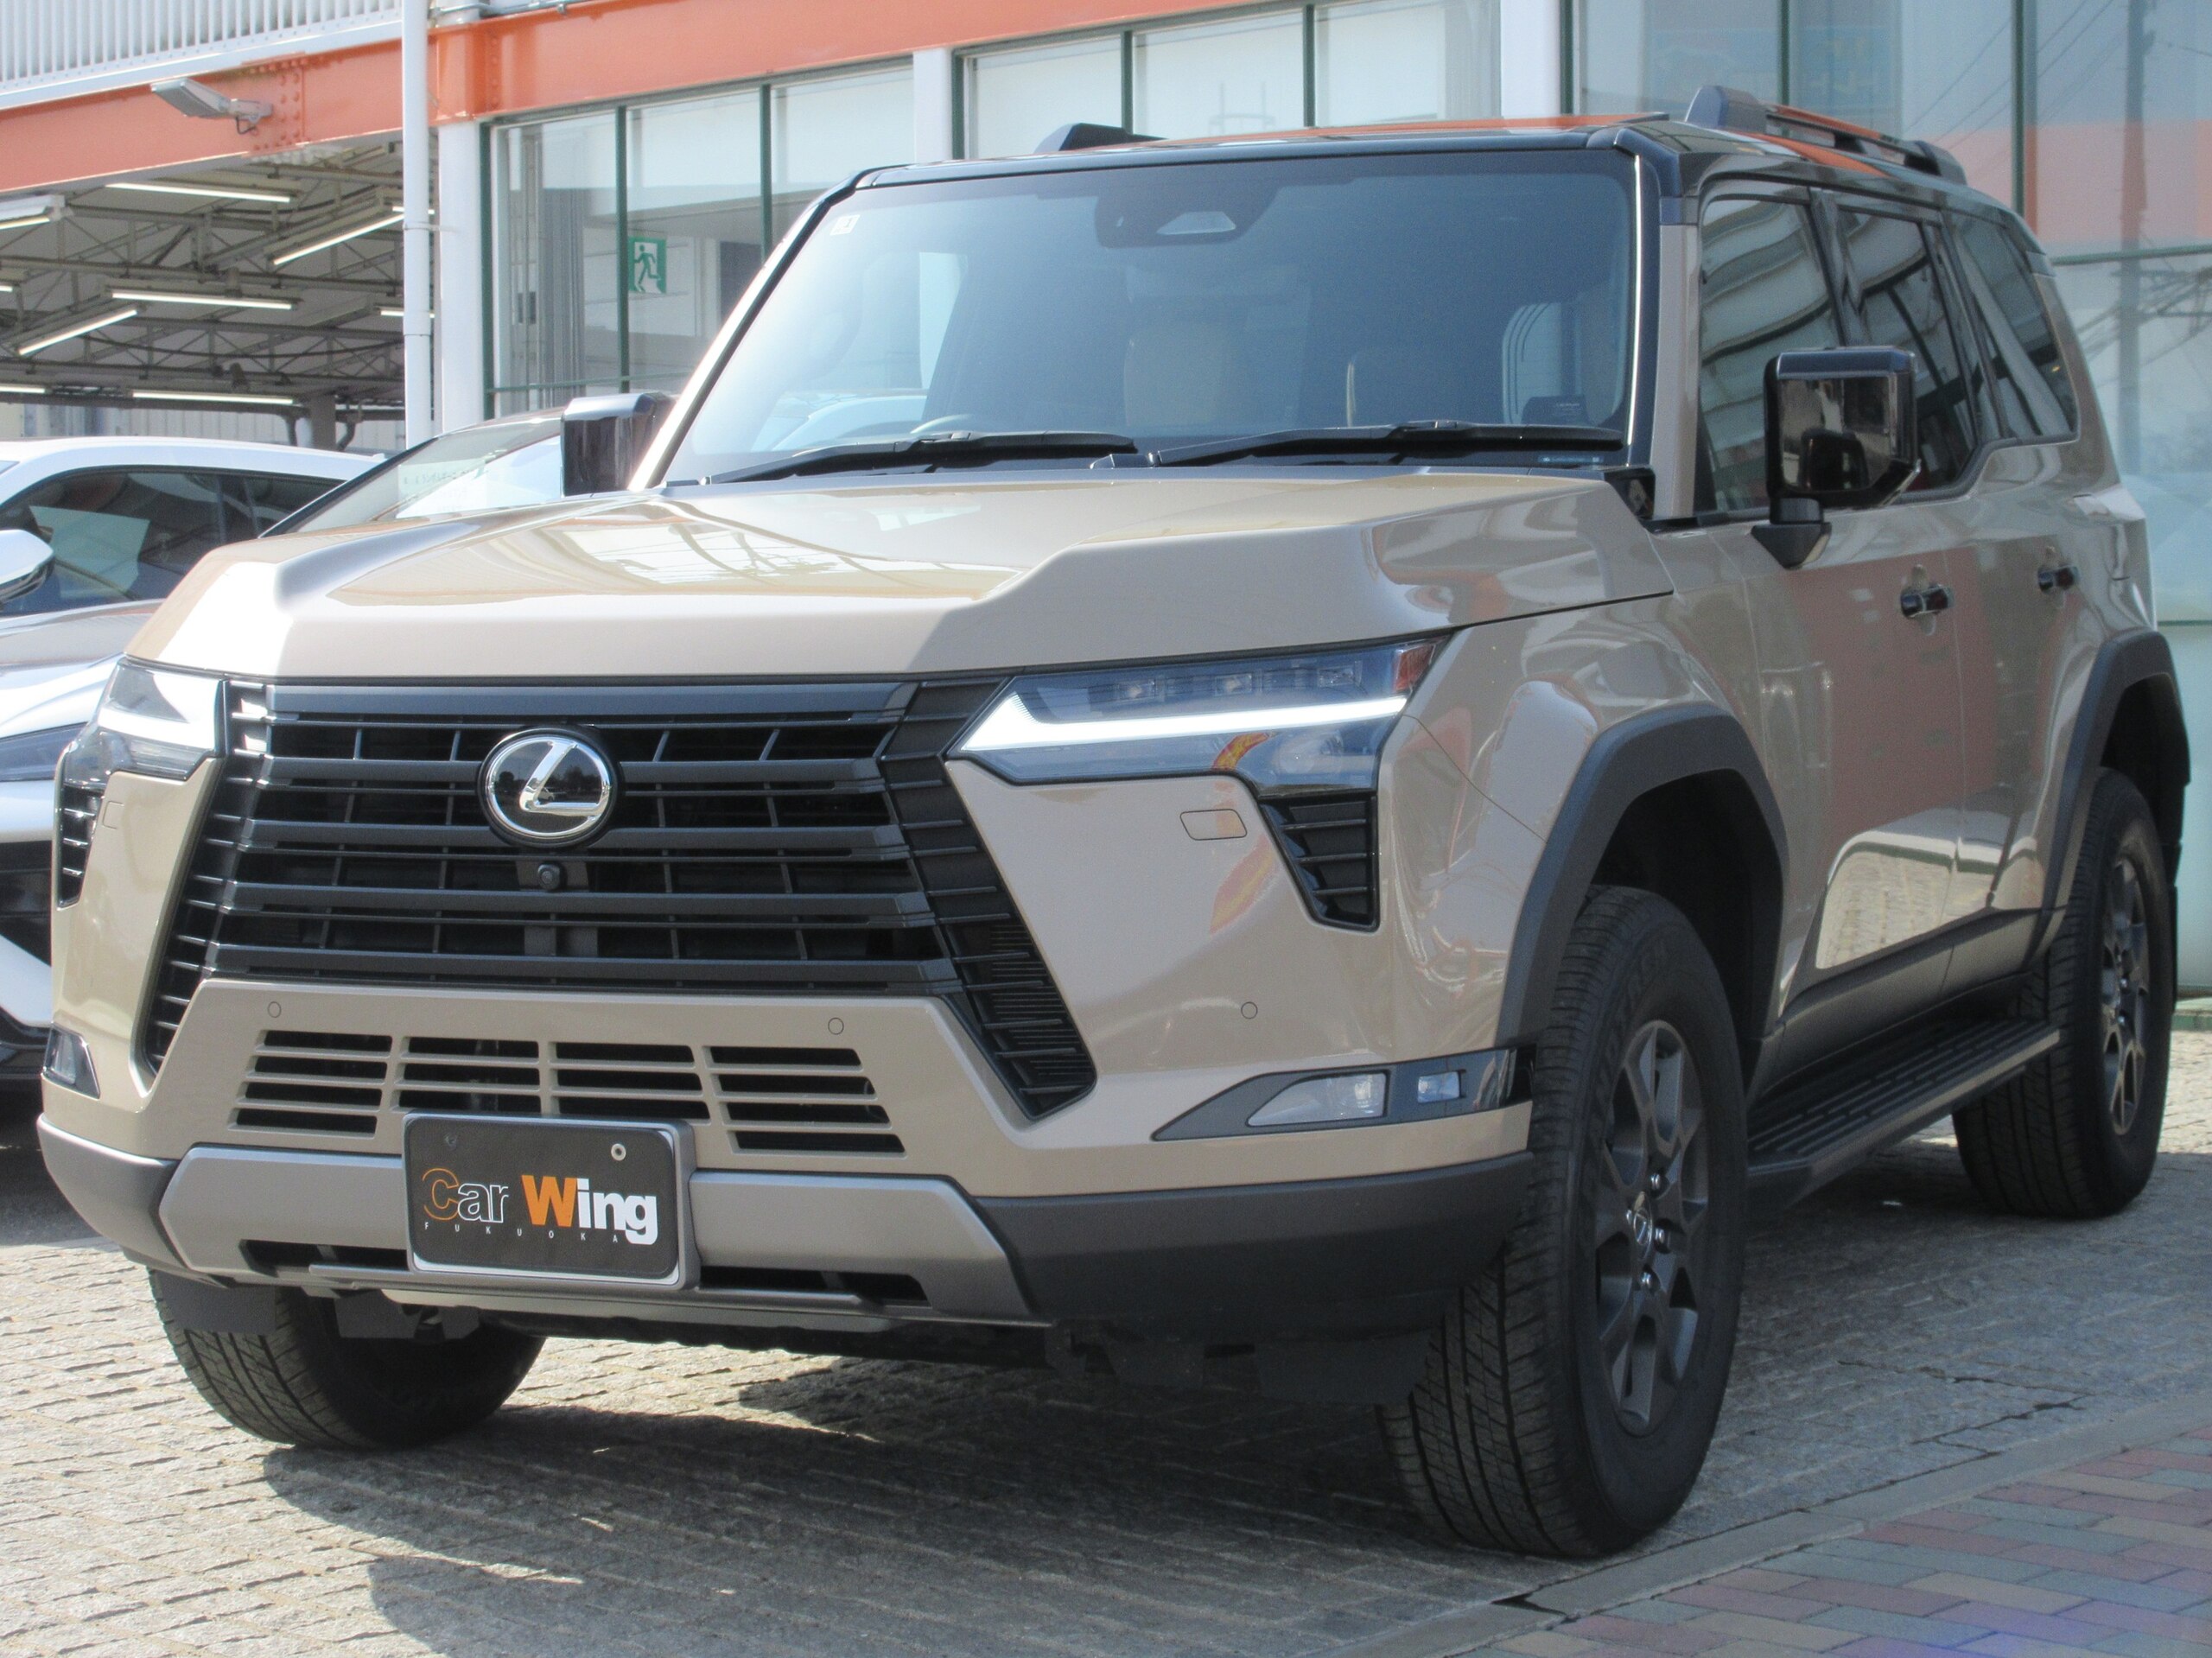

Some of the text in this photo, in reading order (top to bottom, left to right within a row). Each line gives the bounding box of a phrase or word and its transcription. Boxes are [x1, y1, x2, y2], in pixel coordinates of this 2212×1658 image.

[423, 1168, 658, 1245] Car Wing
[424, 1222, 619, 1243] FUKUOKA
